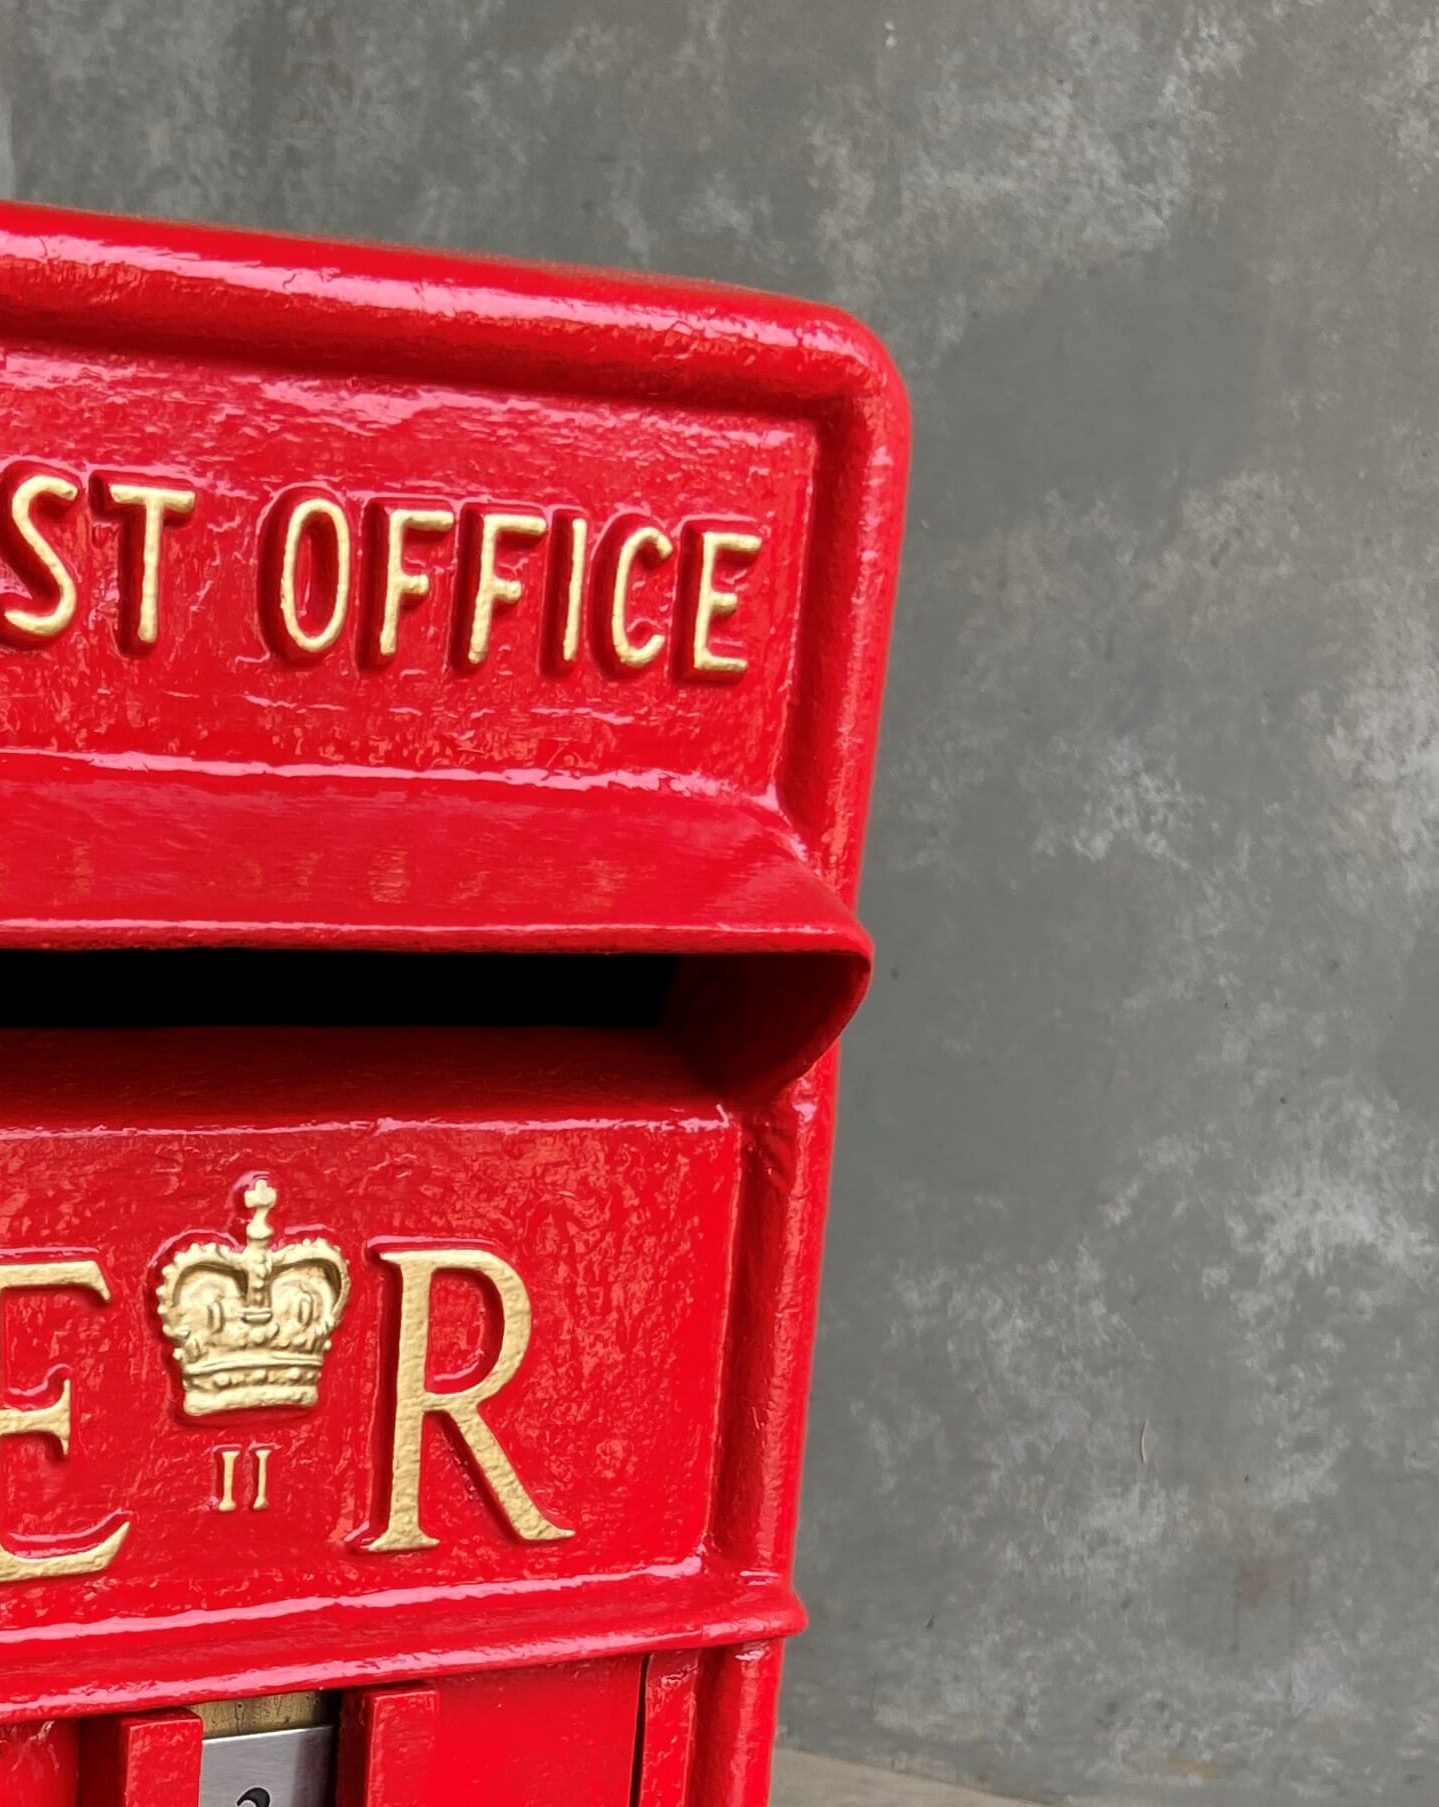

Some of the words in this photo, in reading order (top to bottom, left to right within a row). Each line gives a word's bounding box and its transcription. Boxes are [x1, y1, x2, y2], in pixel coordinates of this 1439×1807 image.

[276, 495, 764, 674] OFFICE
[217, 1450, 272, 1513] II
[368, 1249, 576, 1553] R
